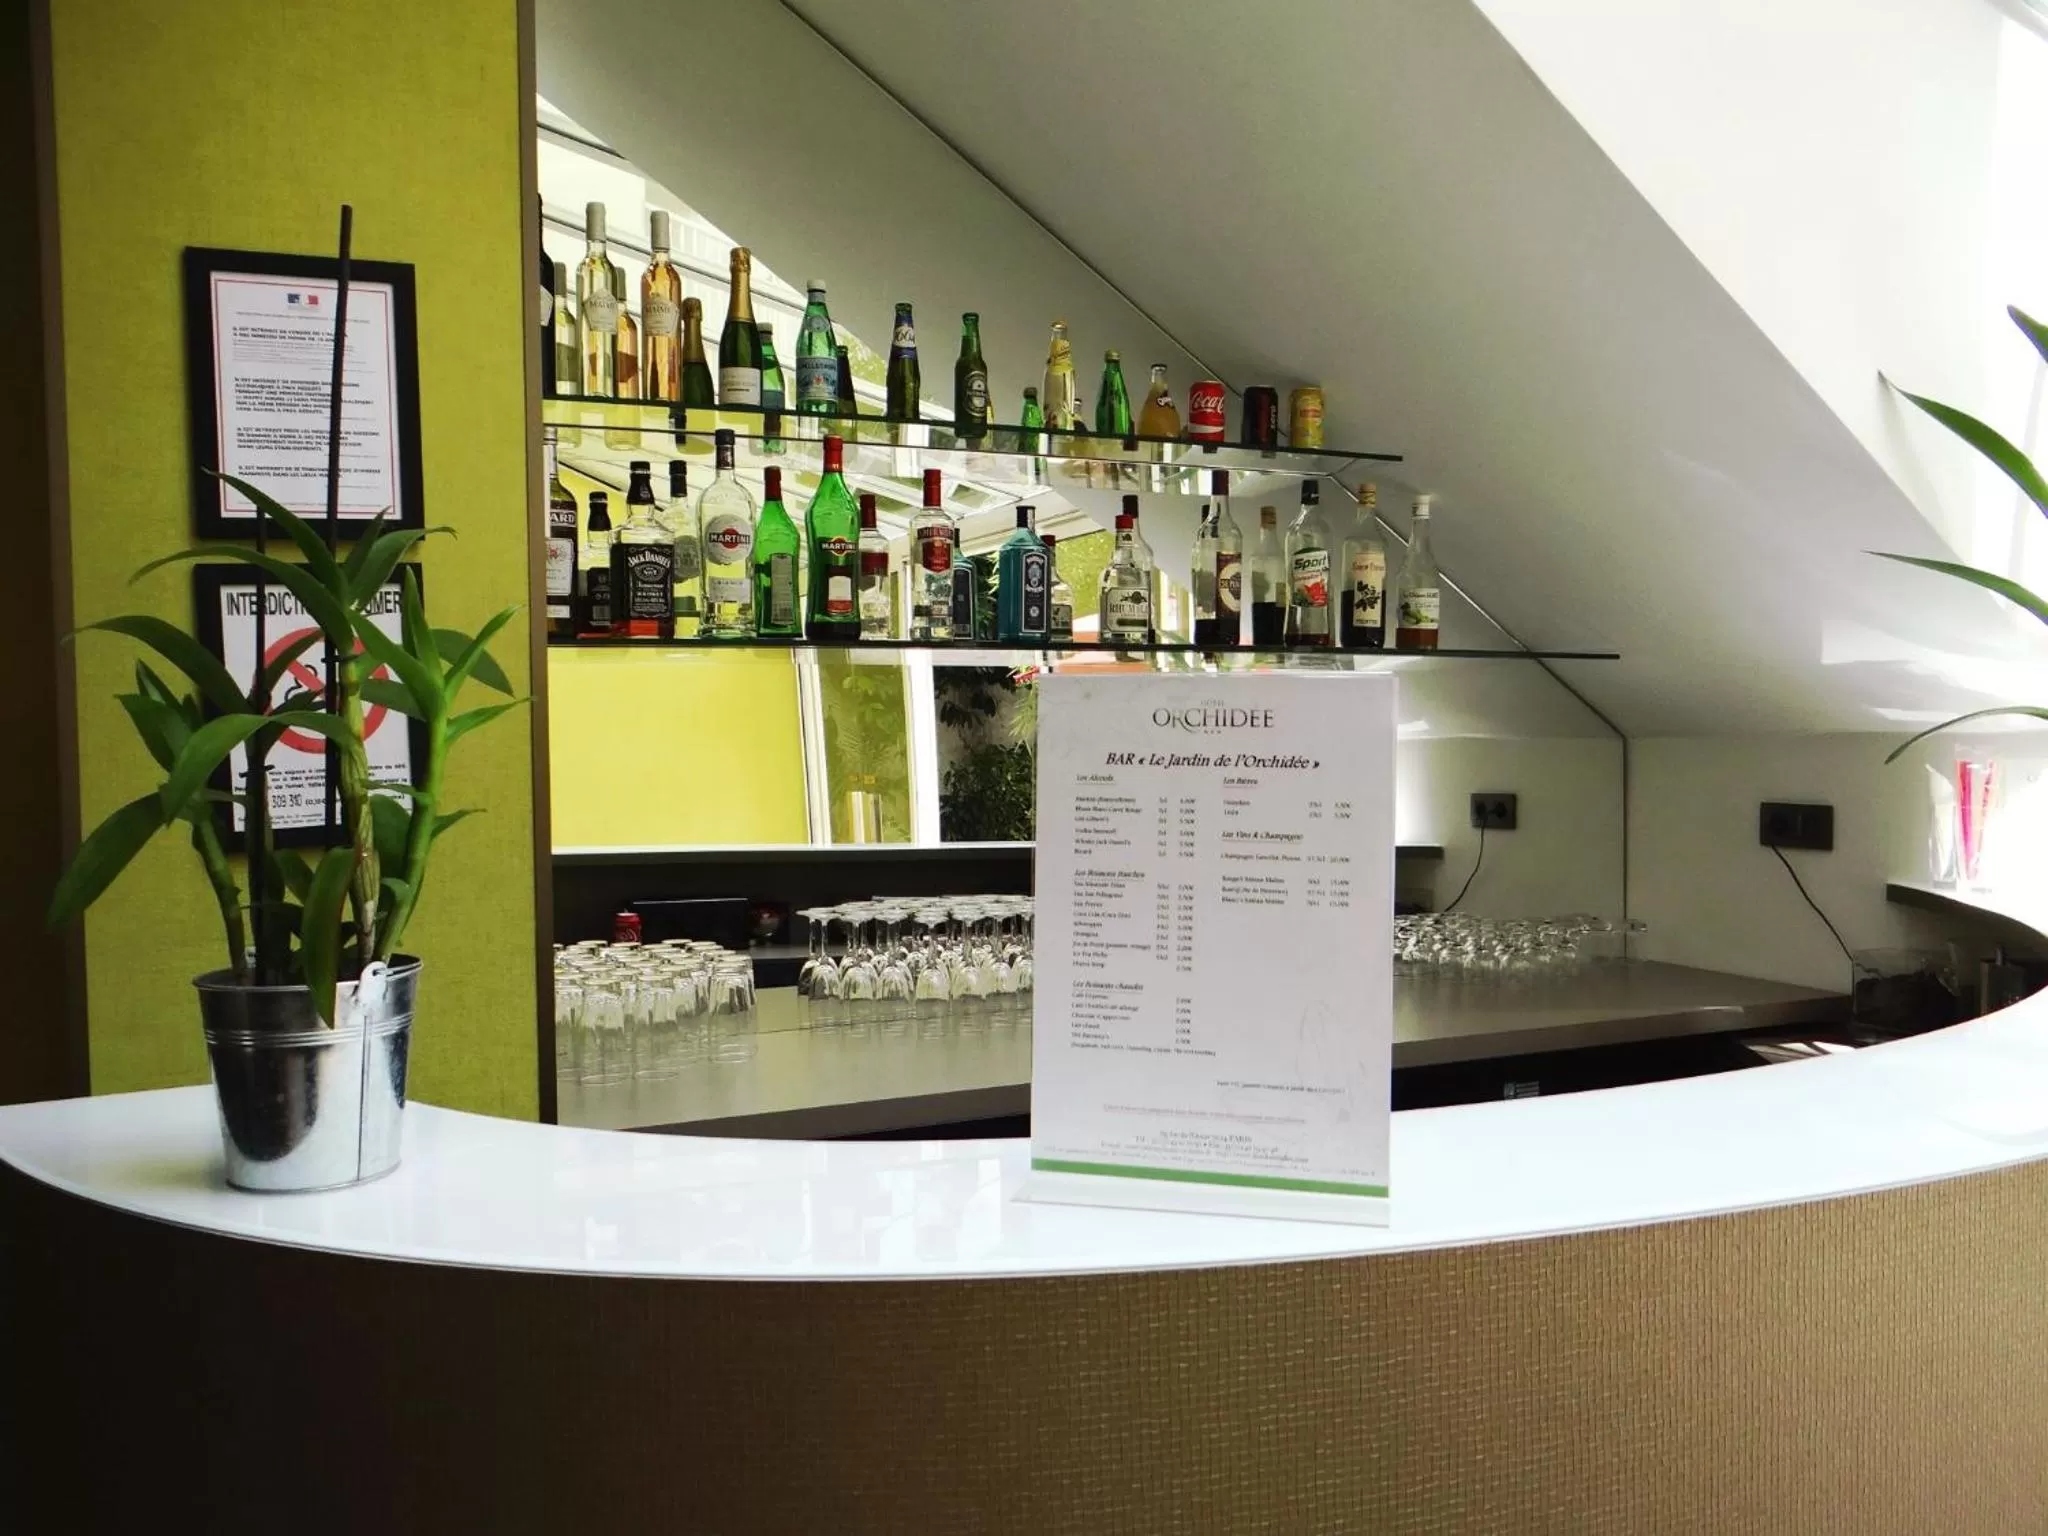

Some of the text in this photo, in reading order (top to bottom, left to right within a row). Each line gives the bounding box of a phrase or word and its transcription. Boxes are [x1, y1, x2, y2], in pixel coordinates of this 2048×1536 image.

[549, 511, 575, 524] ARD
[710, 533, 751, 545] MARTINI
[821, 541, 856, 550] MARTINI
[1294, 554, 1327, 570] Sport
[226, 591, 402, 616] INTEDICTI UMER
[1105, 752, 1136, 766] BAR
[1149, 753, 1165, 766] Le
[1164, 753, 1211, 769] Jardin
[1214, 754, 1231, 767] de
